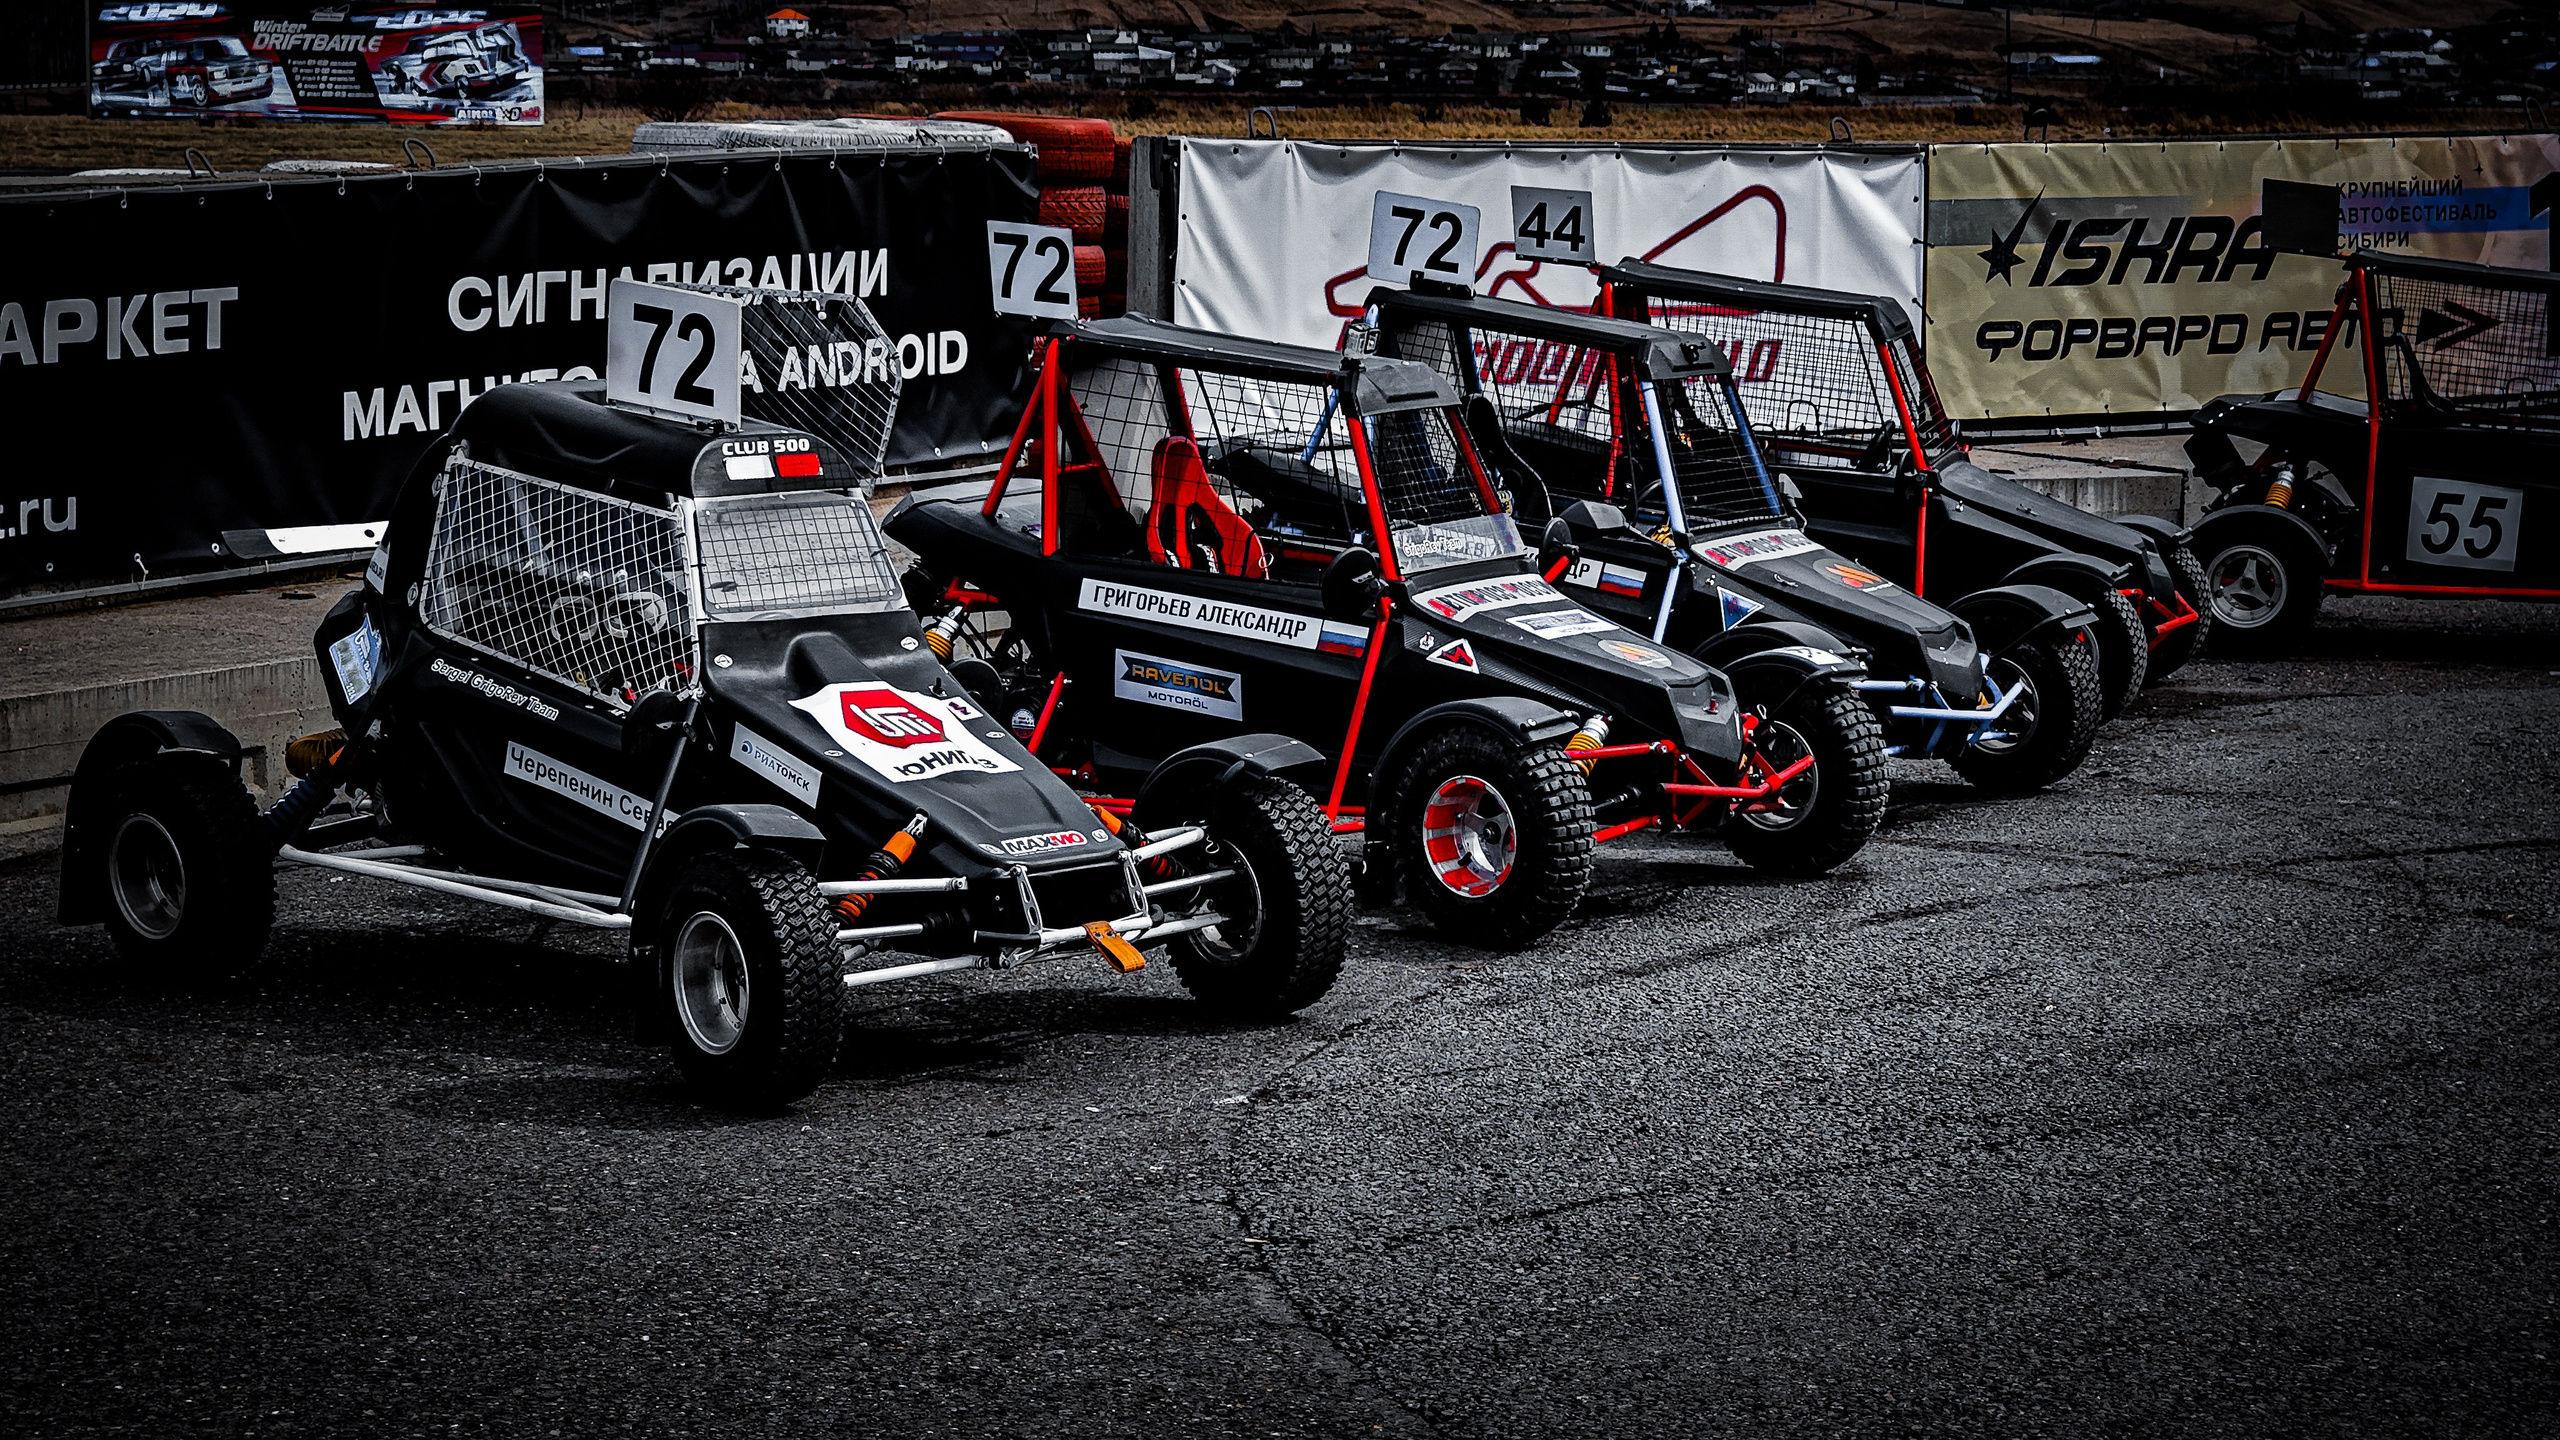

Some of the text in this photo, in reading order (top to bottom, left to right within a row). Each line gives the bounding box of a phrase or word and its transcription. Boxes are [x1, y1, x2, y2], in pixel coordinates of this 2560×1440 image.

[100, 3, 218, 21] 2024
[253, 20, 307, 33] Winter
[251, 33, 384, 52] DRIFTBATTLE
[2336, 175, 2464, 199] КРУПНЕЙШИЙ
[1518, 202, 1585, 252] 44
[2336, 203, 2498, 224] АВТОФЕСТИВАЛЬ
[1391, 205, 1463, 275] 72
[2028, 215, 2277, 287] ISKRA
[2336, 231, 2410, 249] СИБИРИ
[994, 231, 1070, 305] 72
[633, 303, 716, 408] 72
[1976, 312, 2249, 363] ФОРВАРД
[777, 330, 969, 392] ANDROID
[722, 438, 810, 456] CLUB 500
[0, 496, 77, 539] .ru
[2421, 492, 2509, 559] 55
[1093, 585, 1307, 640] ГРИГОРЬЕВ АЛЕКСАНДР
[430, 658, 560, 721] Sergei GrigoRev Team
[1131, 663, 1226, 694] RAVENOL
[1148, 690, 1208, 710] MOTORÖL
[511, 746, 613, 809] Черепенин
[754, 750, 810, 792] РИАТОМСК
